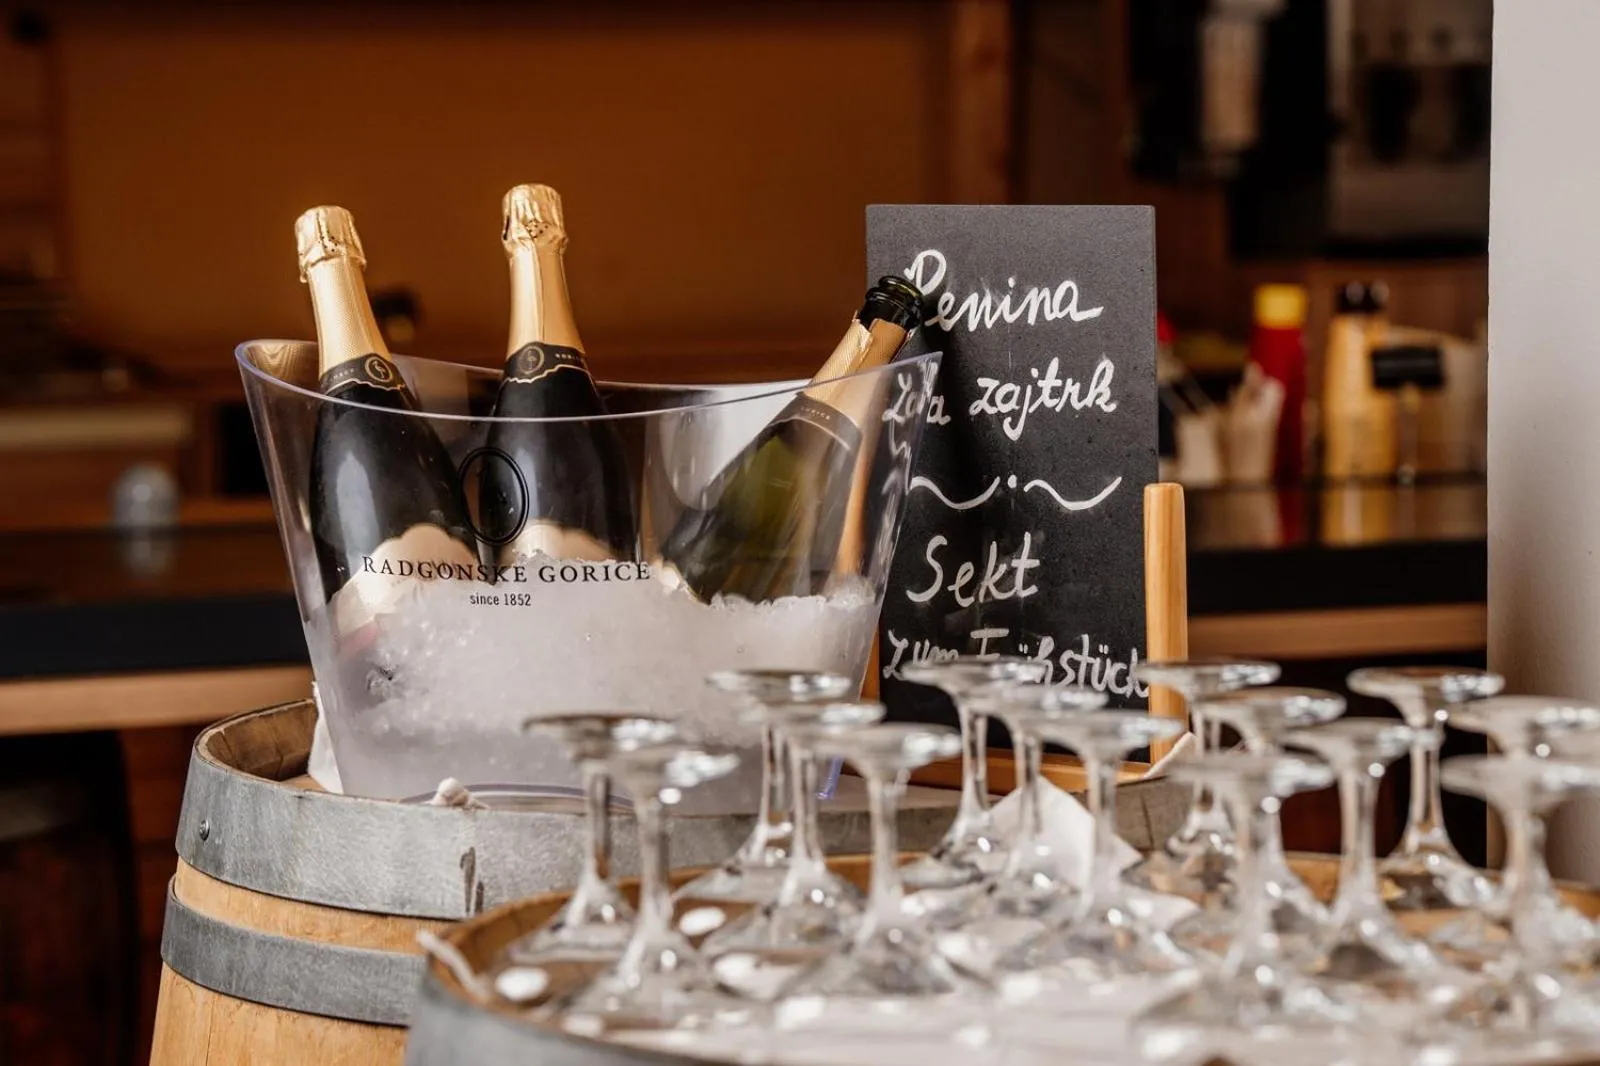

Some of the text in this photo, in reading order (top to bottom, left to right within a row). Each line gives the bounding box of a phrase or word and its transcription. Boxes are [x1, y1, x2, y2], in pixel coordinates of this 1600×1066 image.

[904, 249, 1104, 332] Penina
[969, 356, 1117, 441] zajtrk
[362, 556, 651, 584] RADGONSKE GORICE
[470, 593, 532, 606] since 1852
[906, 531, 1041, 607] Sekt
